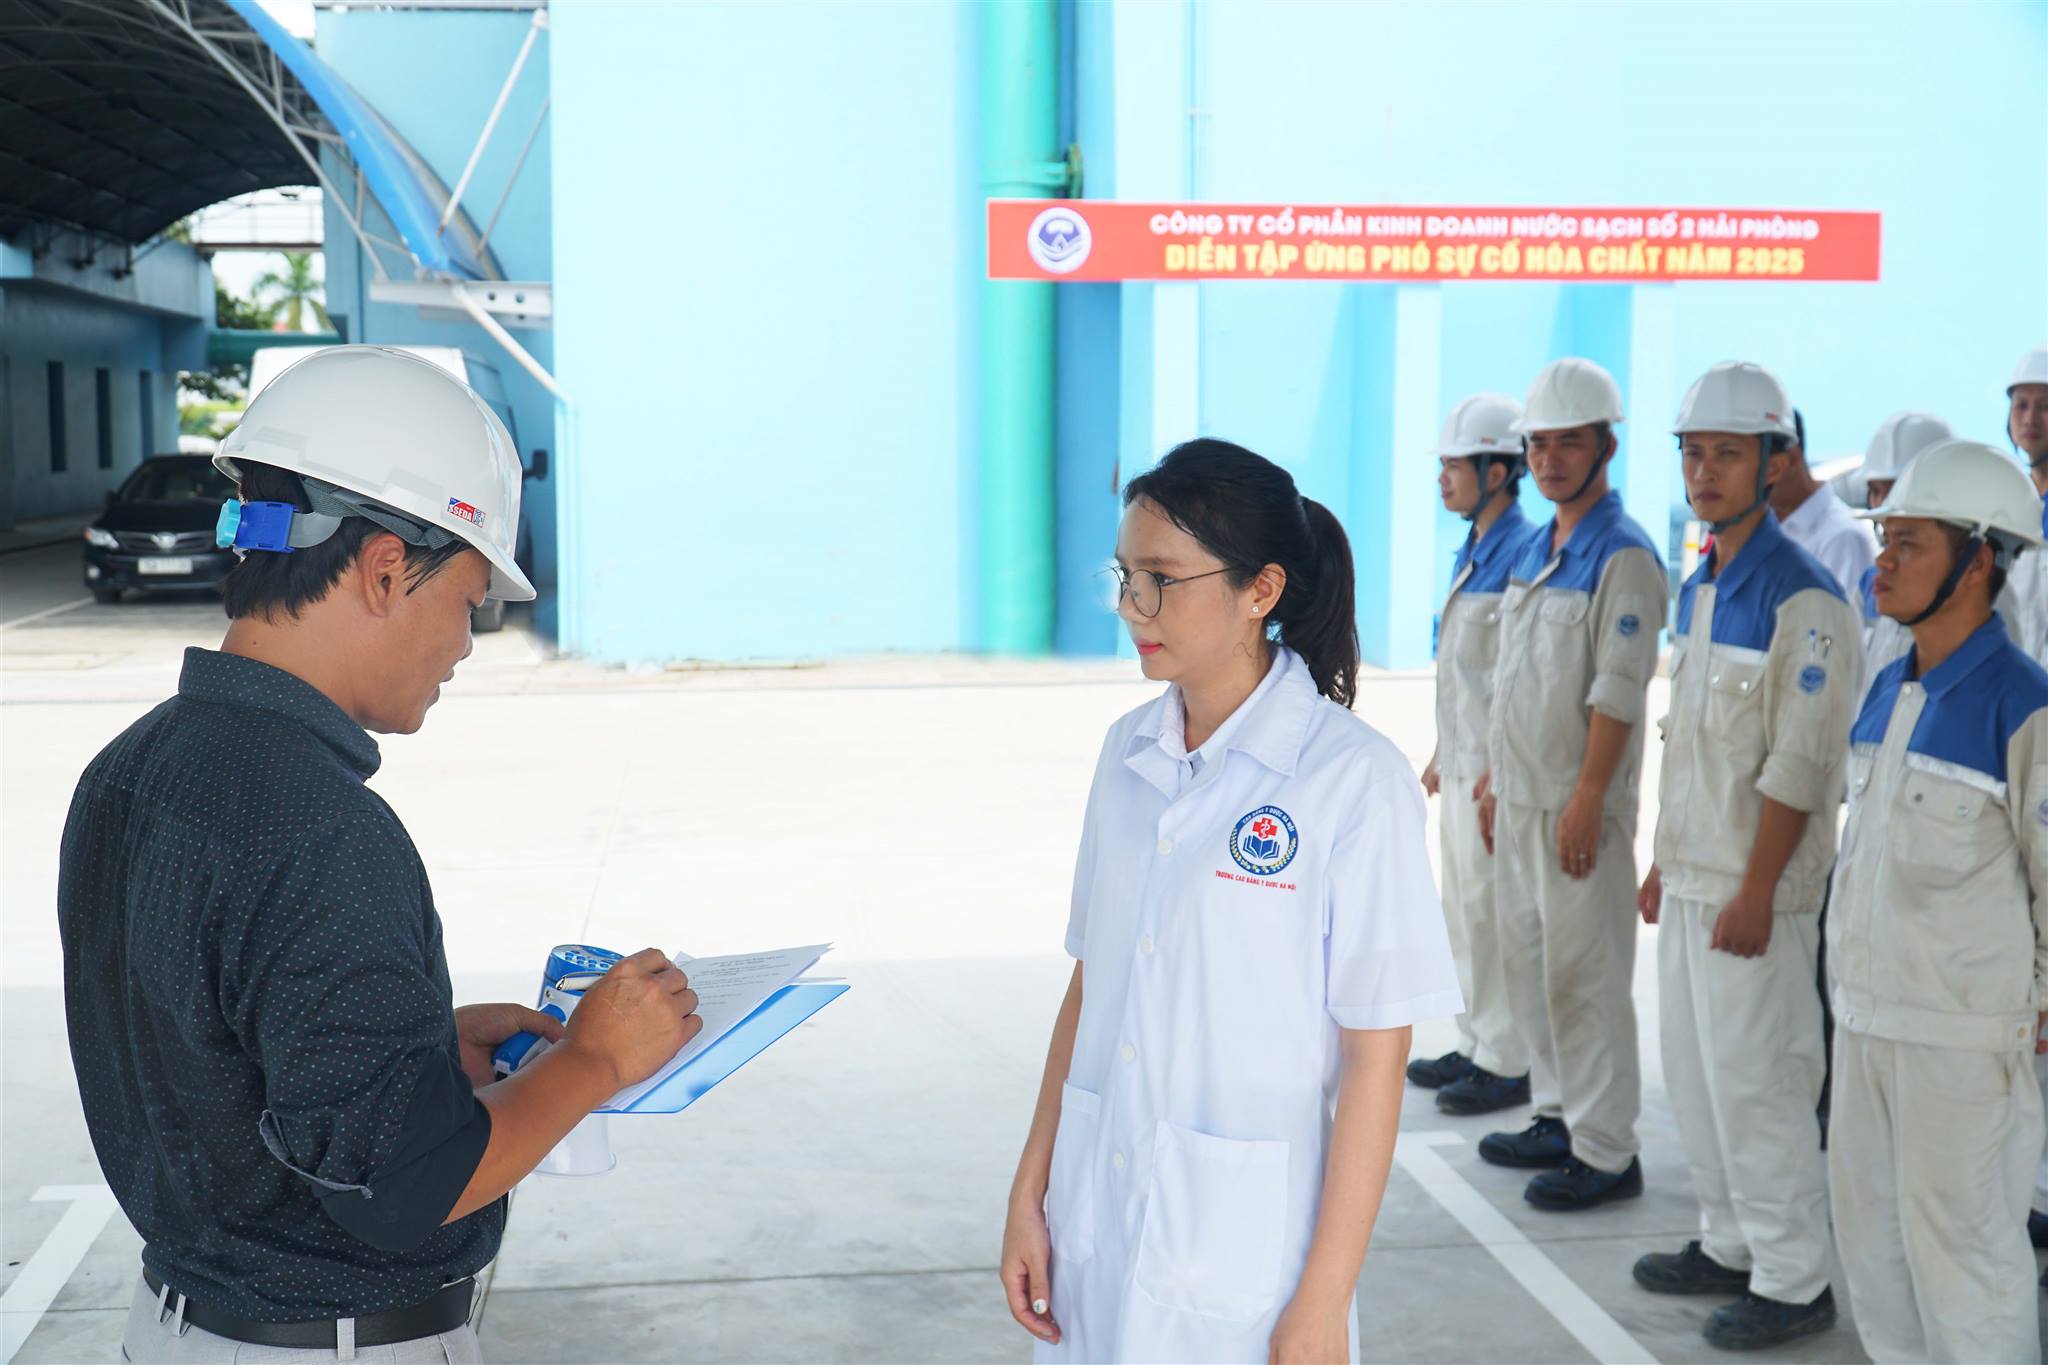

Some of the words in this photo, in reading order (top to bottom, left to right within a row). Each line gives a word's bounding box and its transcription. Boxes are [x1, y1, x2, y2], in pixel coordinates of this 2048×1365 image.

[1150, 210, 1224, 235] CÔNG
[1227, 214, 1254, 235] TY
[1366, 215, 1422, 236] KINH
[1425, 216, 1508, 237] DOANH
[1511, 212, 1579, 238] NƯỚC
[1581, 217, 1643, 242] SẠCH
[1646, 210, 1679, 239] SỐ
[1680, 217, 1695, 239] 2
[1242, 239, 1299, 277] TẬP
[1304, 240, 1366, 272] ỨNG
[1371, 240, 1431, 272] PHÓ
[1436, 243, 1479, 277] SỰ
[1480, 237, 1520, 273] CỐ
[1525, 241, 1584, 273] HÓA
[1588, 238, 1662, 273] CHẤT
[1665, 242, 1732, 274] NĂM
[1735, 247, 1805, 275] 2025
